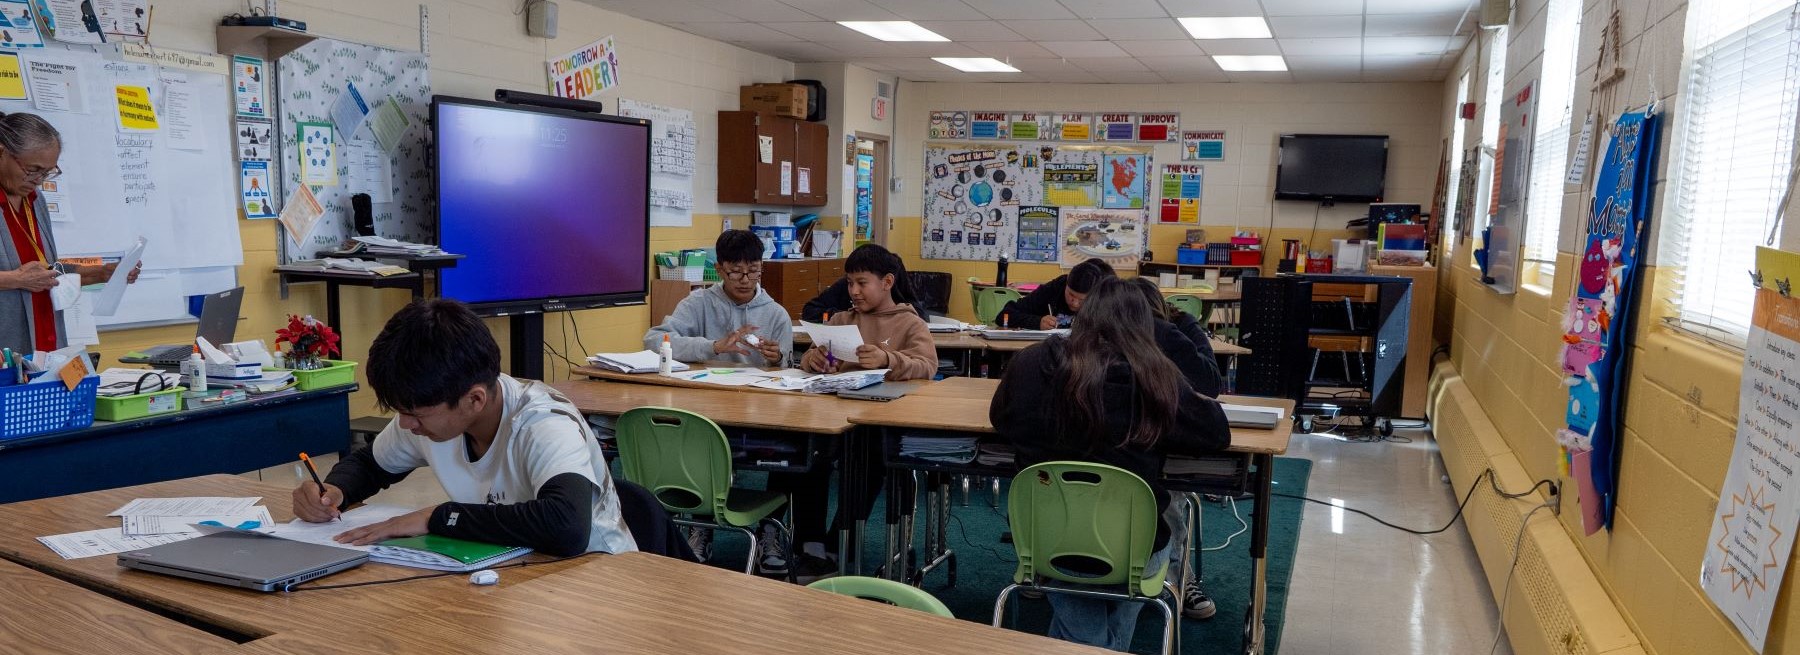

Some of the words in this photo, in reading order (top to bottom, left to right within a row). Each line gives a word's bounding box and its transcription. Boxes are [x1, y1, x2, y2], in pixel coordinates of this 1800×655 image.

[554, 46, 598, 76] TOMORROW
[600, 44, 606, 58] A
[974, 112, 1006, 122] IMAGINE
[1022, 113, 1036, 122] ASK
[1102, 114, 1129, 123] CREATE
[1142, 115, 1176, 124] IMPROVE
[115, 134, 153, 151] Vocabulary
[1167, 165, 1181, 174] THE
[1182, 165, 1189, 174] 4
